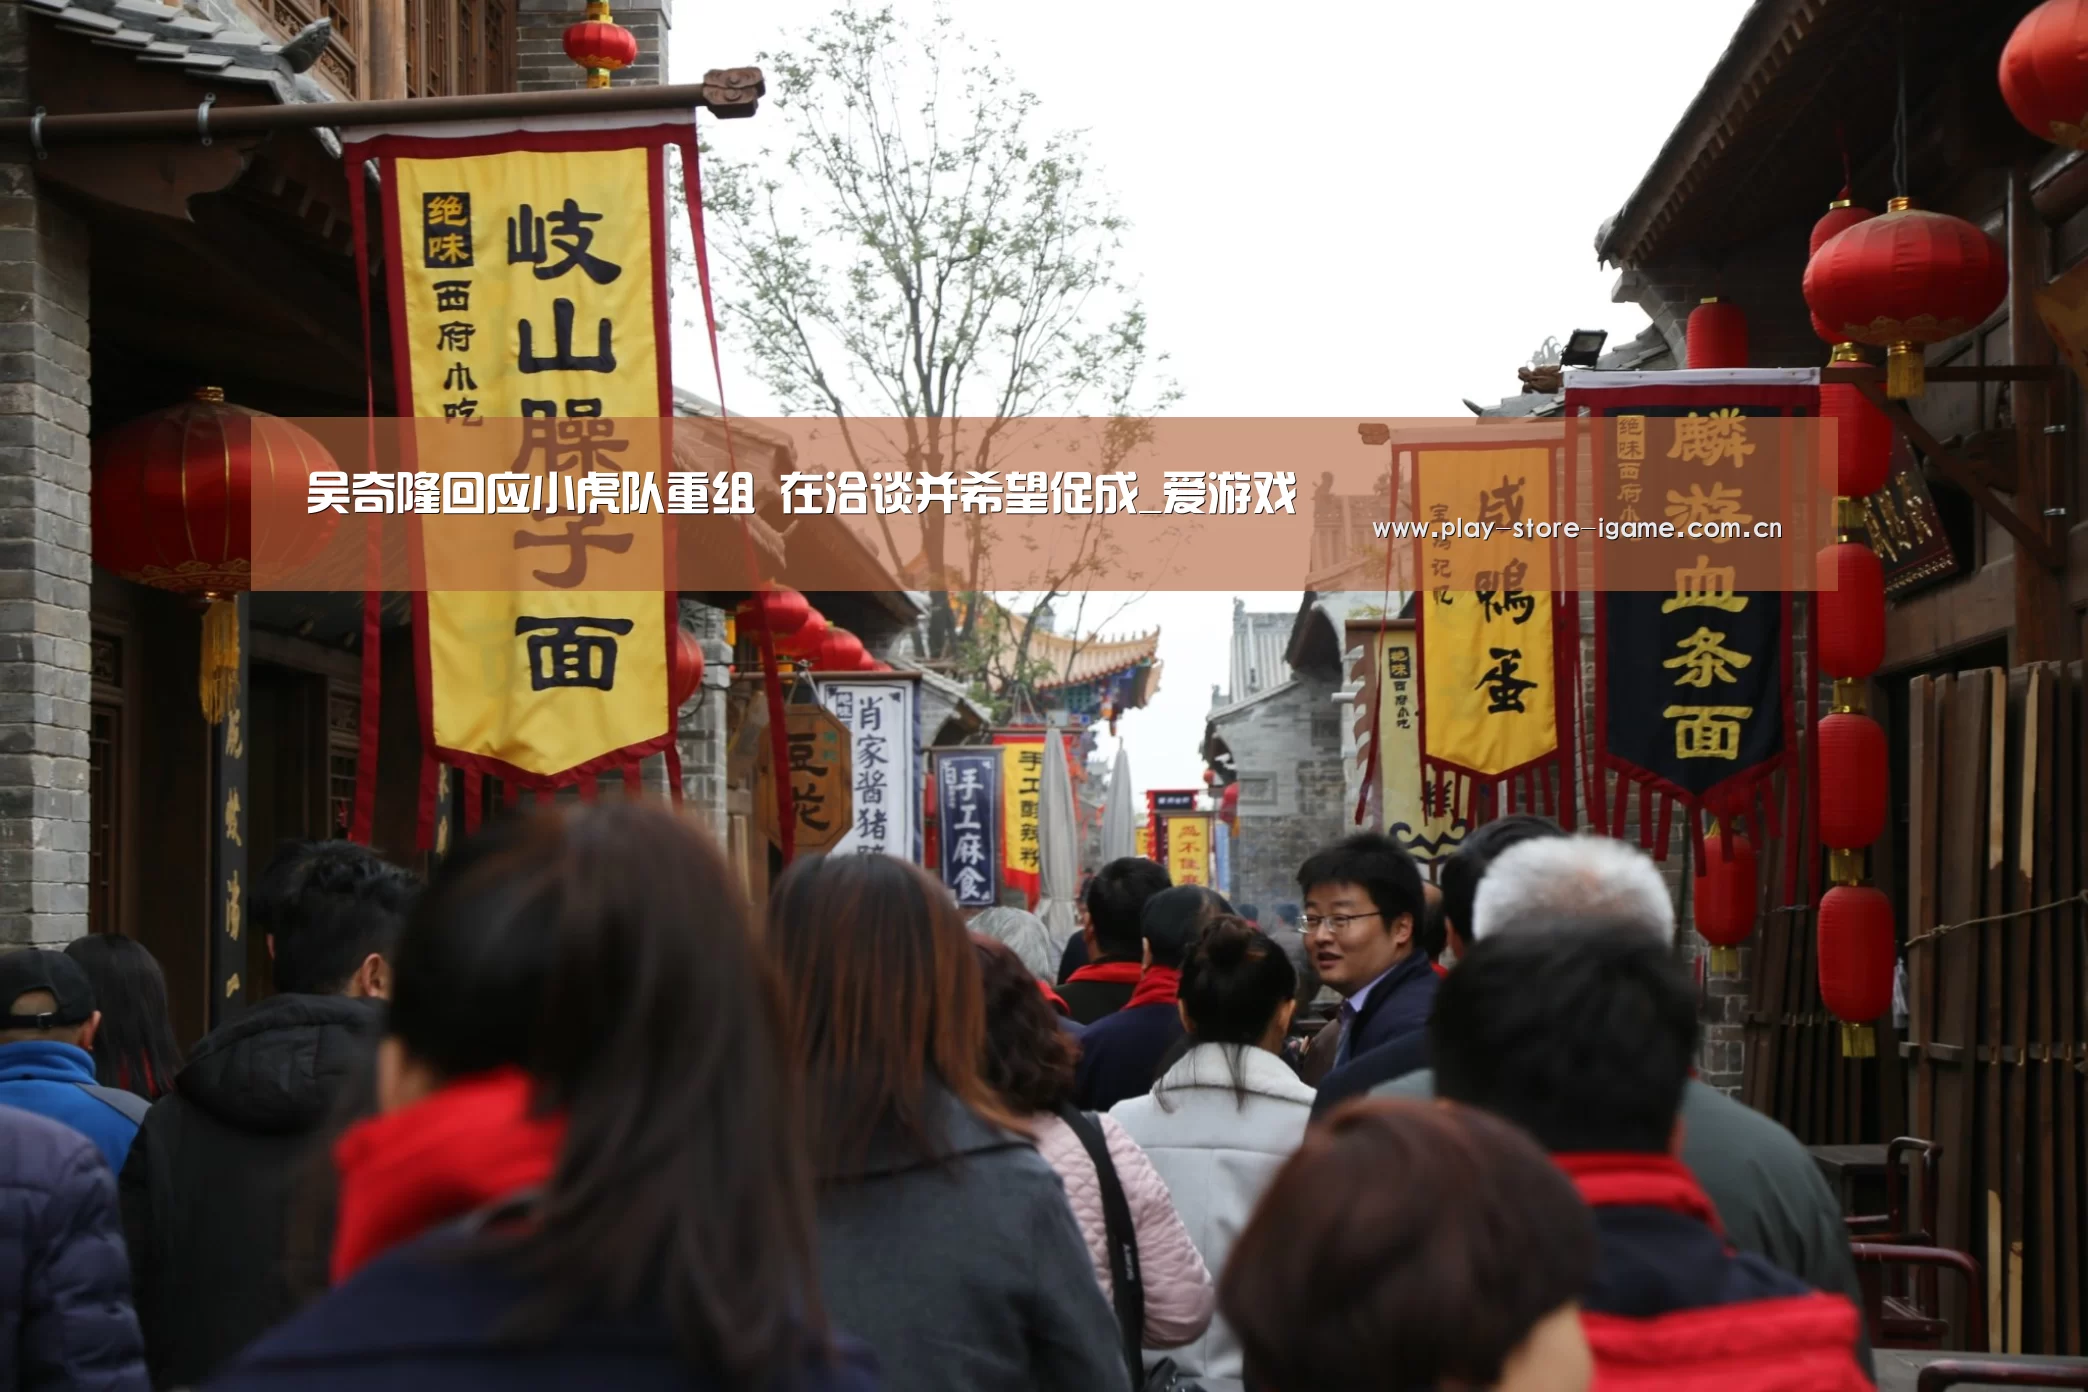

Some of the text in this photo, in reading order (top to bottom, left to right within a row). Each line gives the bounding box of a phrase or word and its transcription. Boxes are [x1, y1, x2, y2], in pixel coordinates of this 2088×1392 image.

[507, 198, 635, 692] 岐山臊子面
[1661, 408, 1756, 760] 麟游血条面
[788, 733, 830, 831] 豆花
[952, 768, 986, 900] 手工麻食
